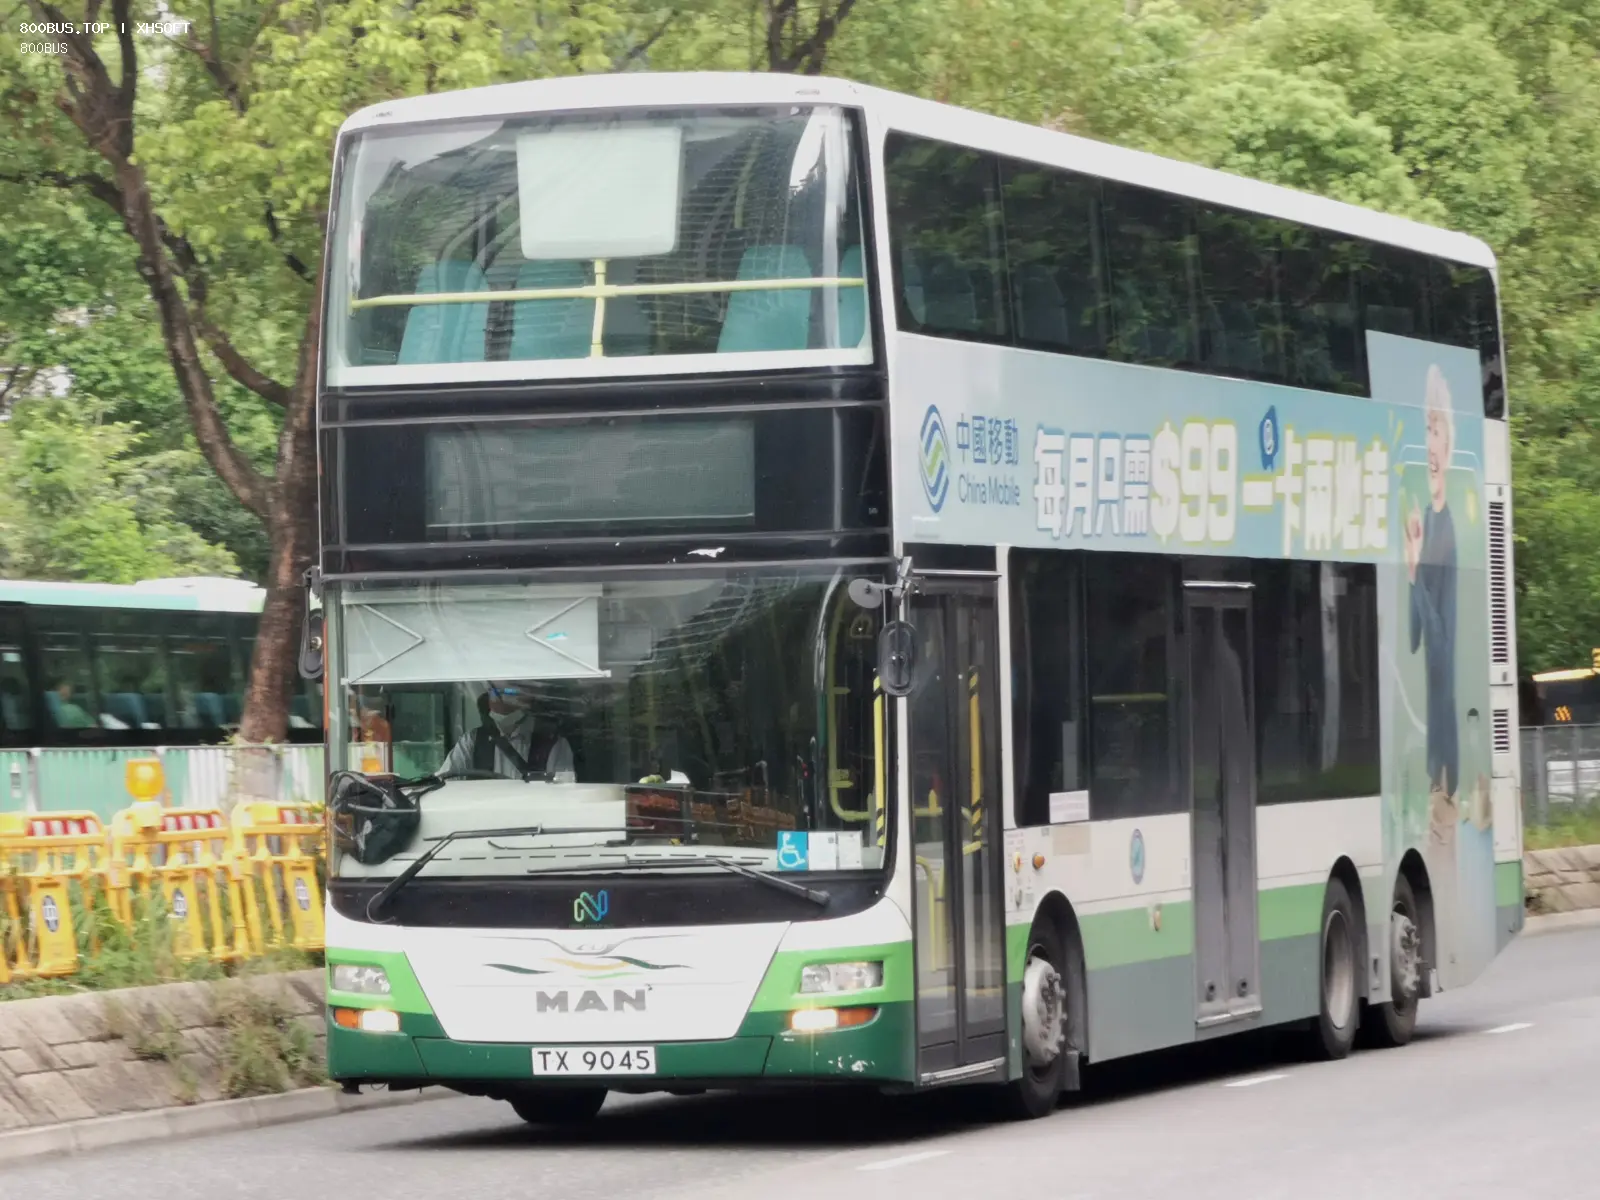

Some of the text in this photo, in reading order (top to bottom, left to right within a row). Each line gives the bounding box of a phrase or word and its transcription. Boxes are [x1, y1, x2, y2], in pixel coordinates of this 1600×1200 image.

[956, 413, 1019, 466] 中國移動
[957, 473, 1020, 507] China Mobile
[535, 988, 647, 1014] MAN
[537, 1050, 651, 1072] TX 9045
